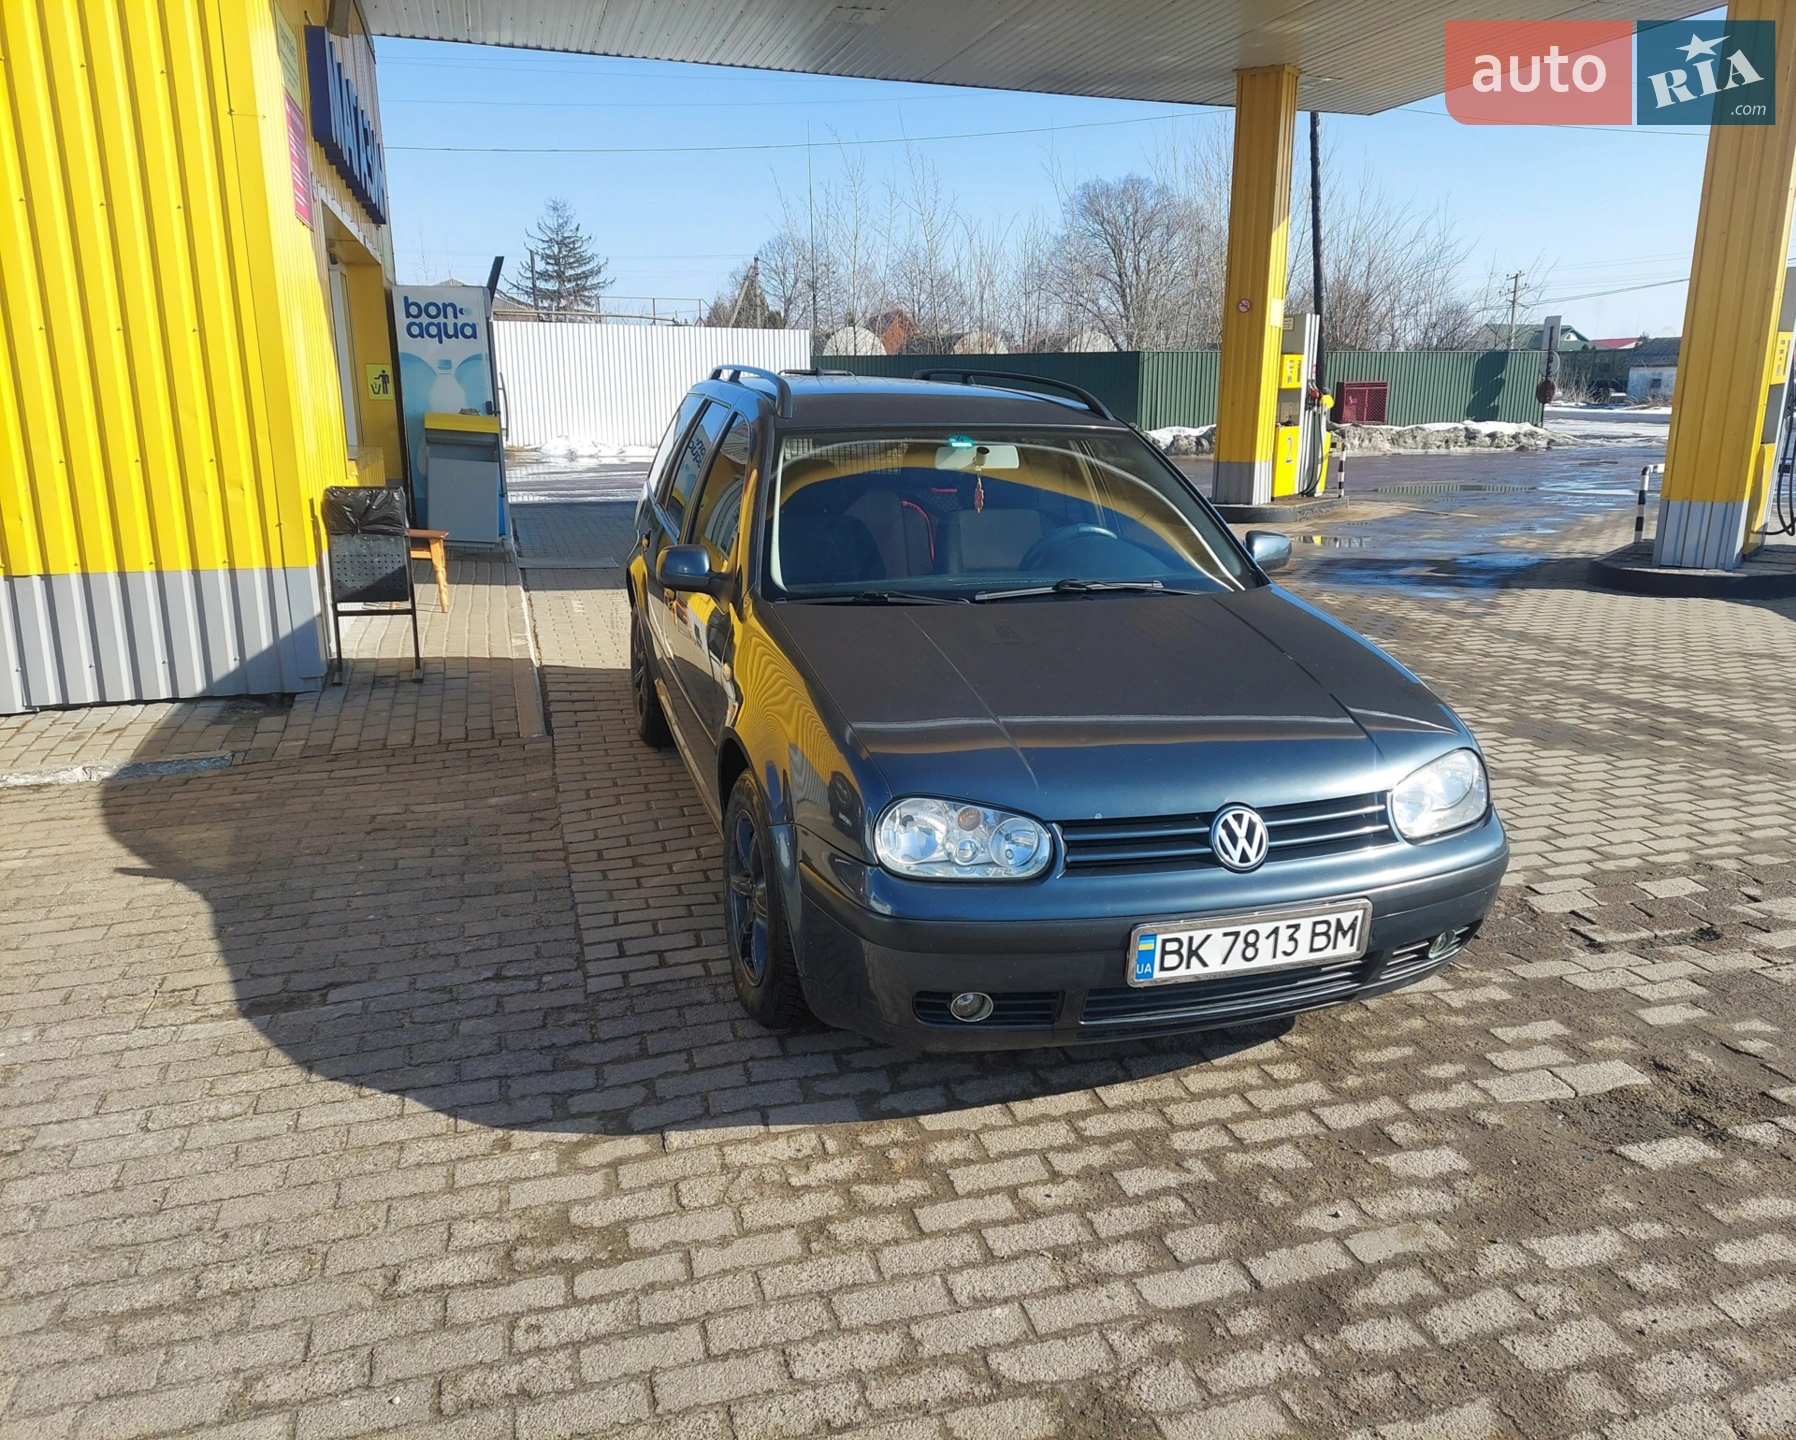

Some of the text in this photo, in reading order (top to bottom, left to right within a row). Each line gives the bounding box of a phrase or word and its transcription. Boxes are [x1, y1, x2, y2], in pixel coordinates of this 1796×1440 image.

[403, 295, 459, 320] bon
[406, 321, 478, 345] aqua
[1285, 436, 1293, 464] 2
[1158, 915, 1360, 972] BK 7813 BM
[1136, 962, 1152, 974] UA
